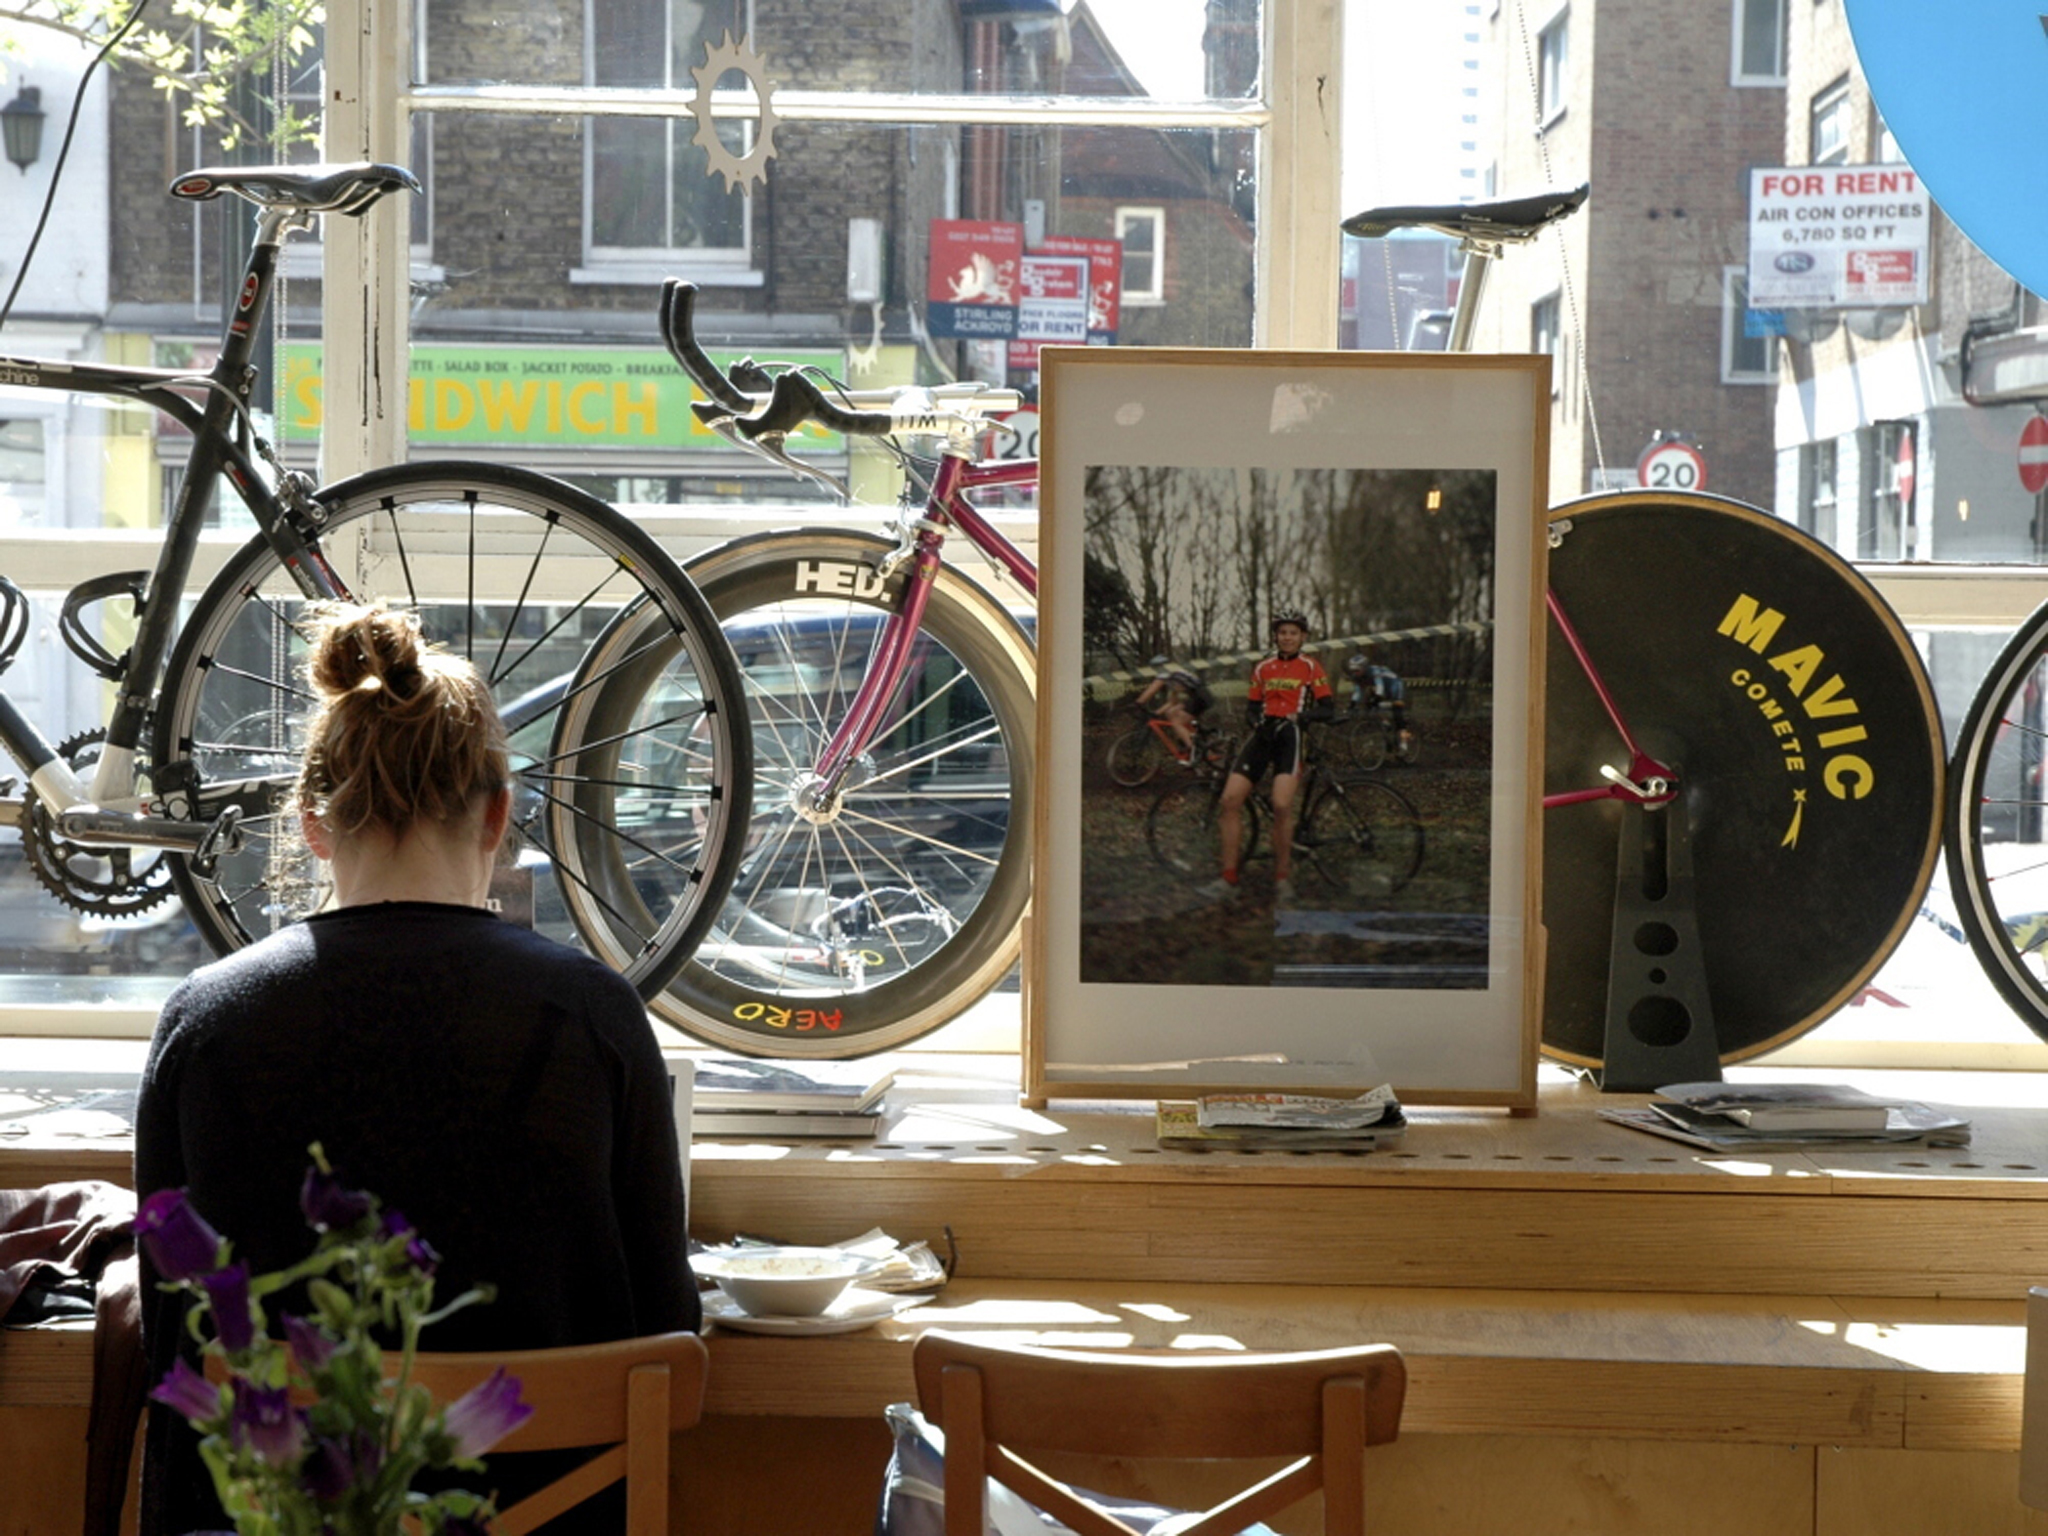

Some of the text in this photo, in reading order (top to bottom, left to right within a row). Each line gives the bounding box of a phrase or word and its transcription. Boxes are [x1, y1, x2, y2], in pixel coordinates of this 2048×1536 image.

[1763, 171, 1916, 197] FOR RENT
[1758, 203, 1923, 222] AIR CON OFFICES
[1783, 225, 1896, 244] 6,780 SQ FT
[954, 307, 1012, 322] STIRLING
[954, 320, 1013, 334] ACKROYD
[1020, 322, 1083, 334] OR RENT
[445, 360, 481, 373] SALAD
[485, 361, 509, 374] BOX
[522, 361, 567, 375] JACKET
[570, 363, 612, 375] POTATO
[1652, 462, 1695, 487] 20
[1716, 592, 1874, 800] MAVIC
[1730, 668, 1806, 772] COMETE
[733, 1002, 844, 1032] AERO
